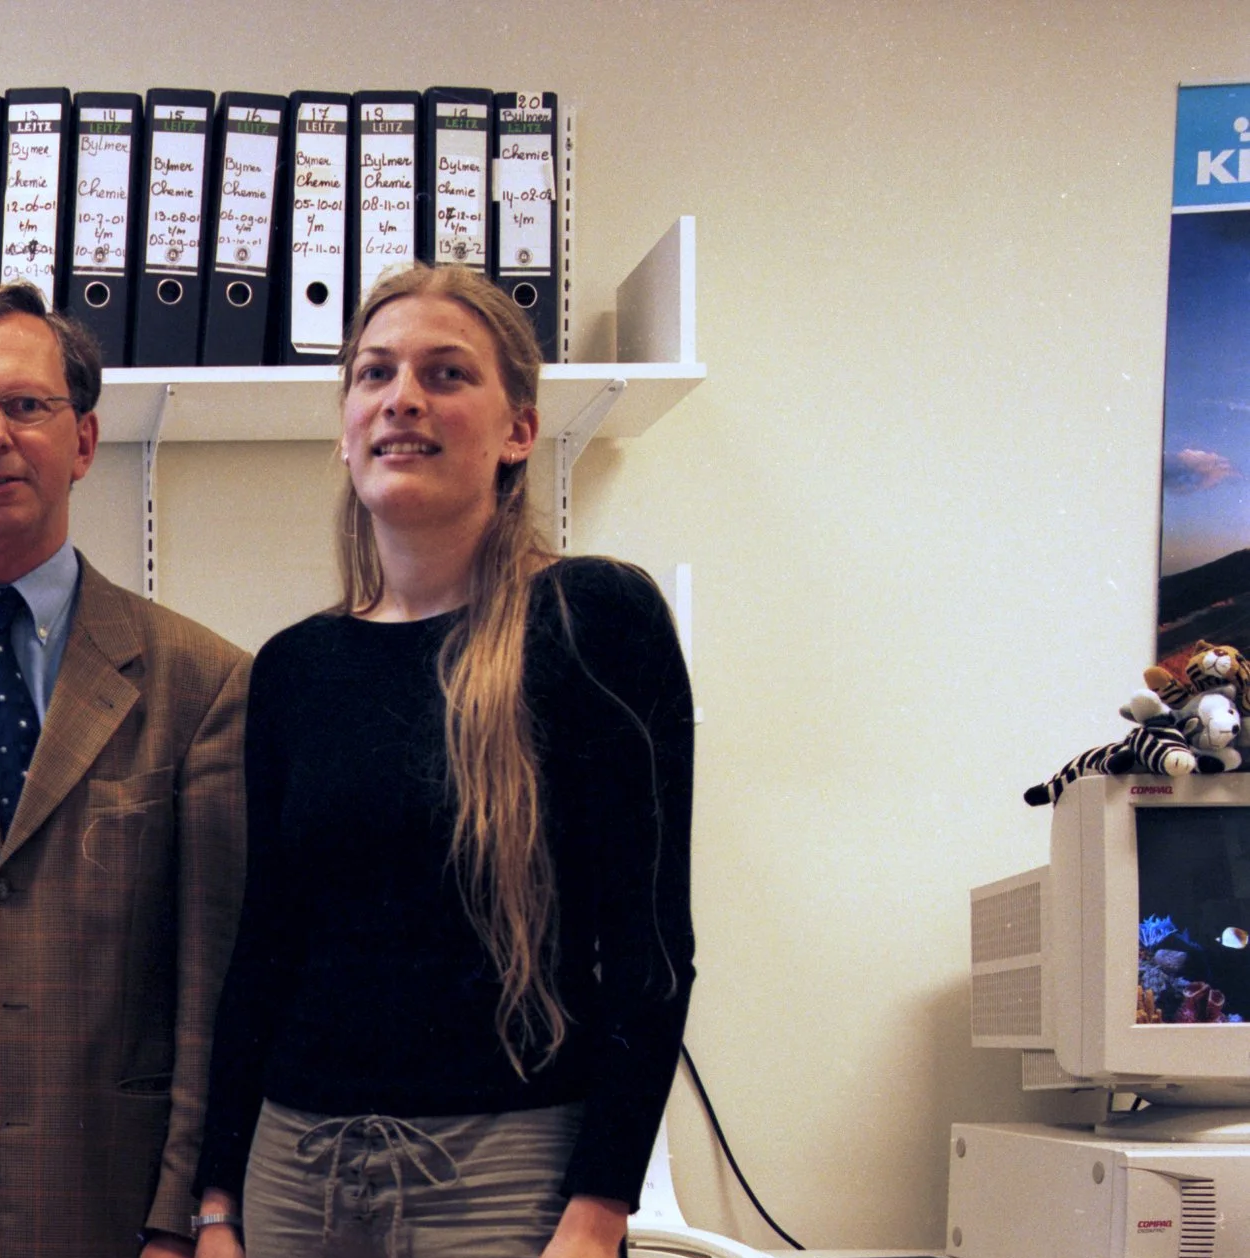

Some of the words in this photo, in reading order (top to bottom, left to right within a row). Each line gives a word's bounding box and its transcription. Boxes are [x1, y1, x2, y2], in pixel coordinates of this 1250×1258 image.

[518, 96, 541, 109] 20
[25, 110, 39, 121] 13
[103, 110, 116, 123] 14
[169, 110, 185, 121] 15
[246, 109, 262, 123] 16
[312, 107, 329, 124] 17
[366, 107, 384, 121] 18
[17, 122, 51, 132] LEITZ
[90, 124, 121, 133] LEITZ
[163, 122, 196, 132] LEITZ
[237, 124, 270, 133] LEITZ
[306, 122, 336, 132] LEITZ
[372, 122, 403, 132] LEITZ
[445, 119, 478, 129] LEITZ
[508, 123, 542, 133] LEITZ
[502, 144, 549, 160] Chemie
[296, 172, 341, 189] Chemie
[364, 172, 412, 189] Chemie
[78, 177, 127, 200] Chemie
[151, 180, 193, 198] Chemie
[223, 180, 267, 199] Chemie
[438, 181, 476, 198] Chemie
[379, 221, 397, 235] t/m
[1130, 785, 1173, 795] COMPAQ
[1137, 1220, 1172, 1228] COMPAQ
